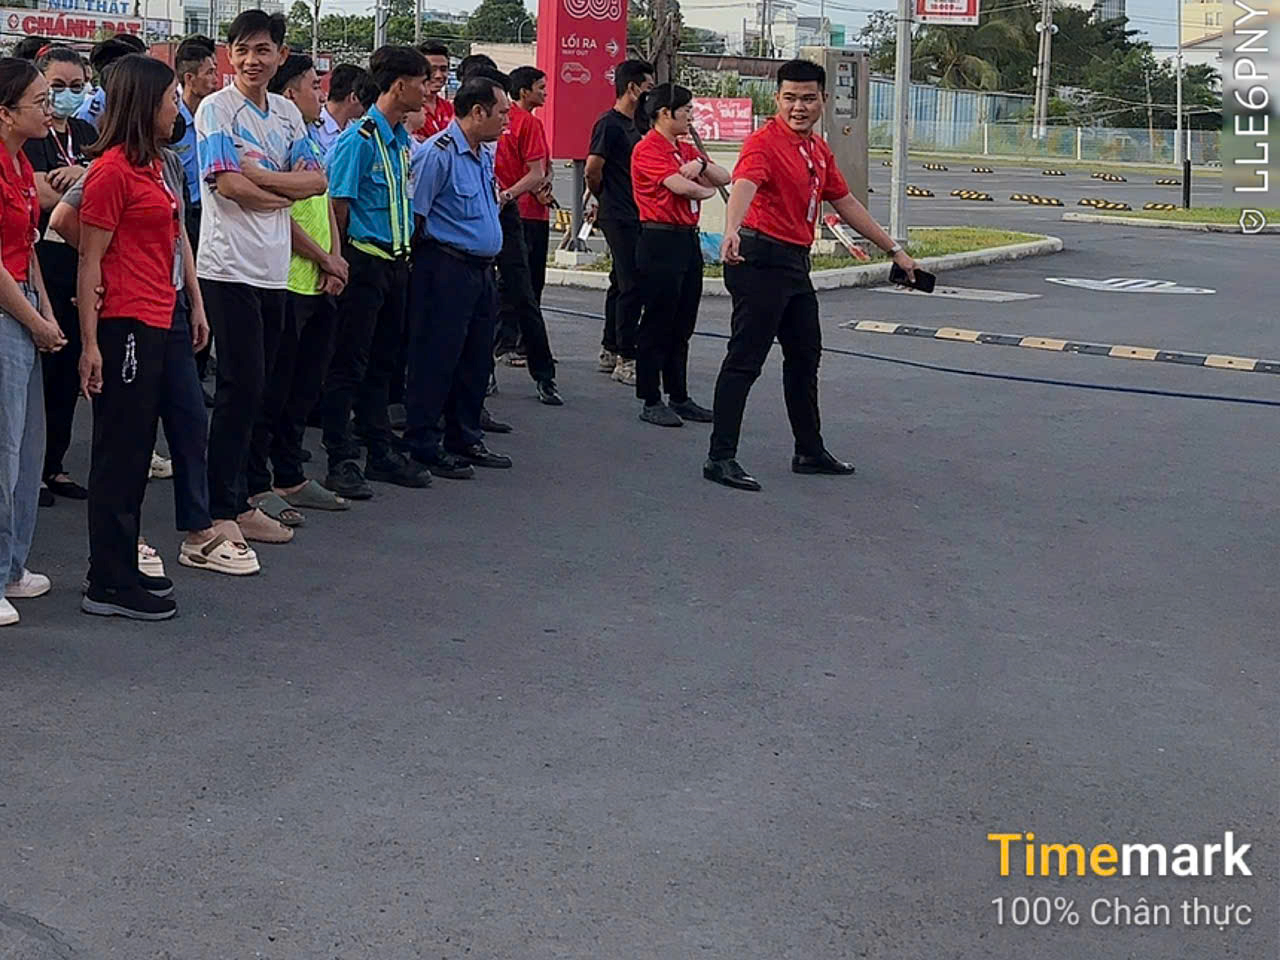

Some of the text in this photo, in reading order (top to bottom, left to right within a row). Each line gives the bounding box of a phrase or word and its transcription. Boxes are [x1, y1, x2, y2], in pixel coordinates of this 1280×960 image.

[22, 12, 96, 37] CHÁNH
[561, 32, 598, 49] LỐI RA
